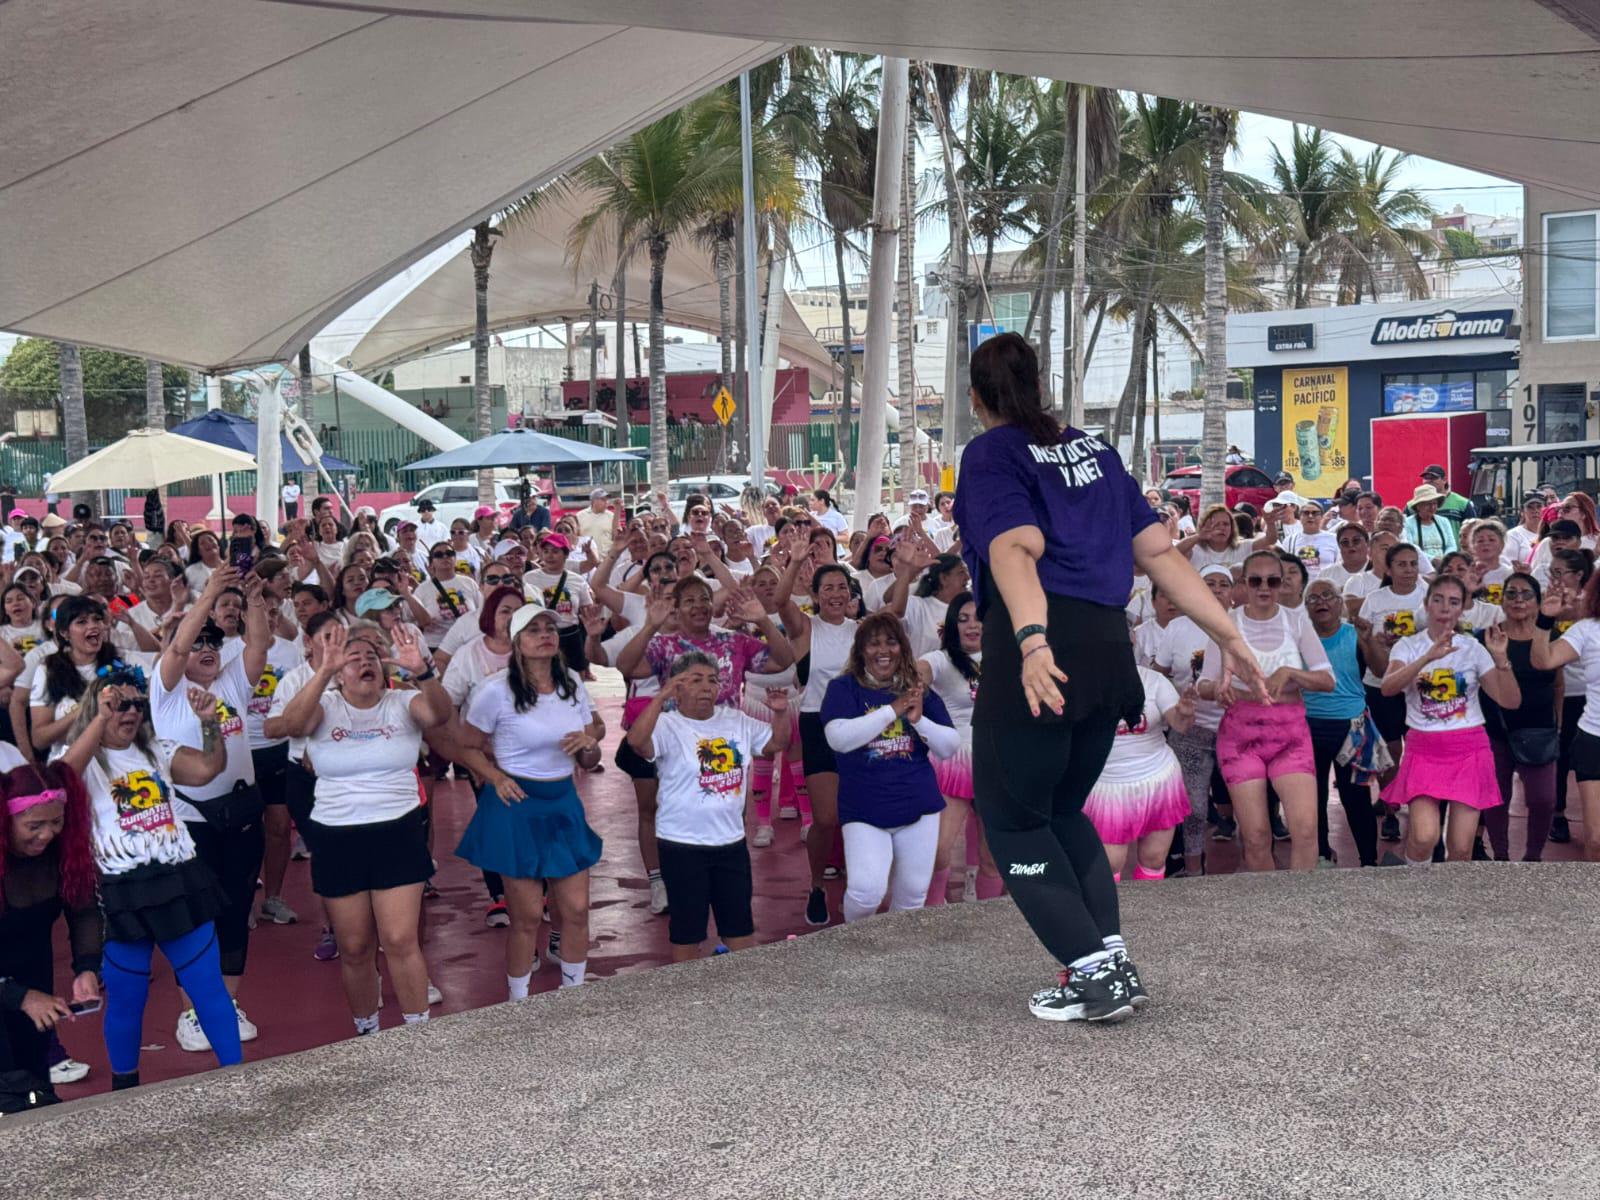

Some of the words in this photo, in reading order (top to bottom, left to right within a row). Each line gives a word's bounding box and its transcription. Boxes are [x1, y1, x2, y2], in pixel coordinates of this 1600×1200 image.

[1294, 374, 1336, 388] CARNAVAL
[1523, 384, 1536, 442] 107
[1431, 668, 1457, 701] 5
[711, 737, 734, 773] 5
[128, 769, 160, 809] 5
[1009, 862, 1046, 875] ZUMBA
